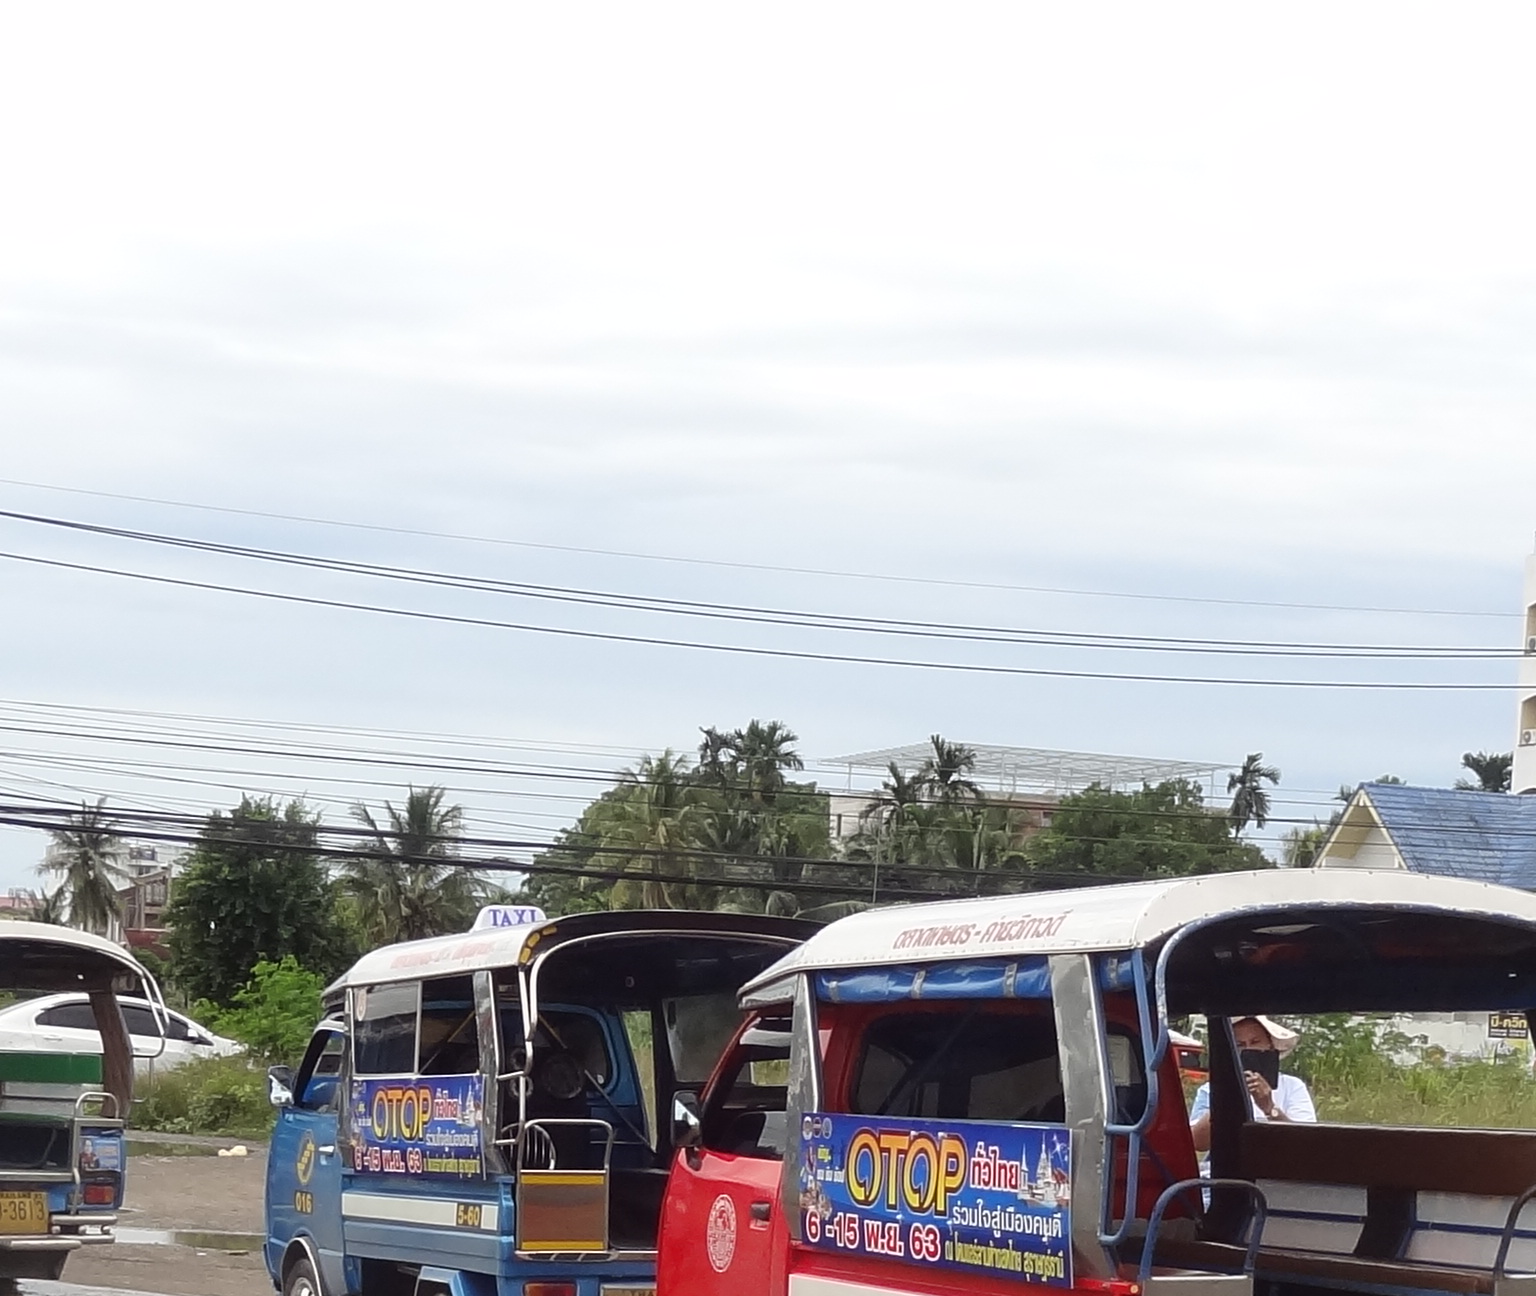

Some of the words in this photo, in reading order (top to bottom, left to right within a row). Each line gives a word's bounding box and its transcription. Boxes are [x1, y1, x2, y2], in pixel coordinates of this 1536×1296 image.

[489, 909, 537, 926] TAXI
[371, 1085, 433, 1143] OTOP
[406, 1147, 423, 1173] 63
[846, 1127, 968, 1219] OTOP
[970, 1141, 1020, 1193] ทั่วไทย
[295, 1191, 313, 1214] 016
[457, 1204, 480, 1226] 5-60
[952, 1198, 1063, 1240] ร่วมใจสู่เมืองคนดี
[806, 1206, 820, 1243] 6
[825, 1211, 860, 1250] -15
[864, 1219, 905, 1257] พ.ย.
[909, 1223, 942, 1262] 63
